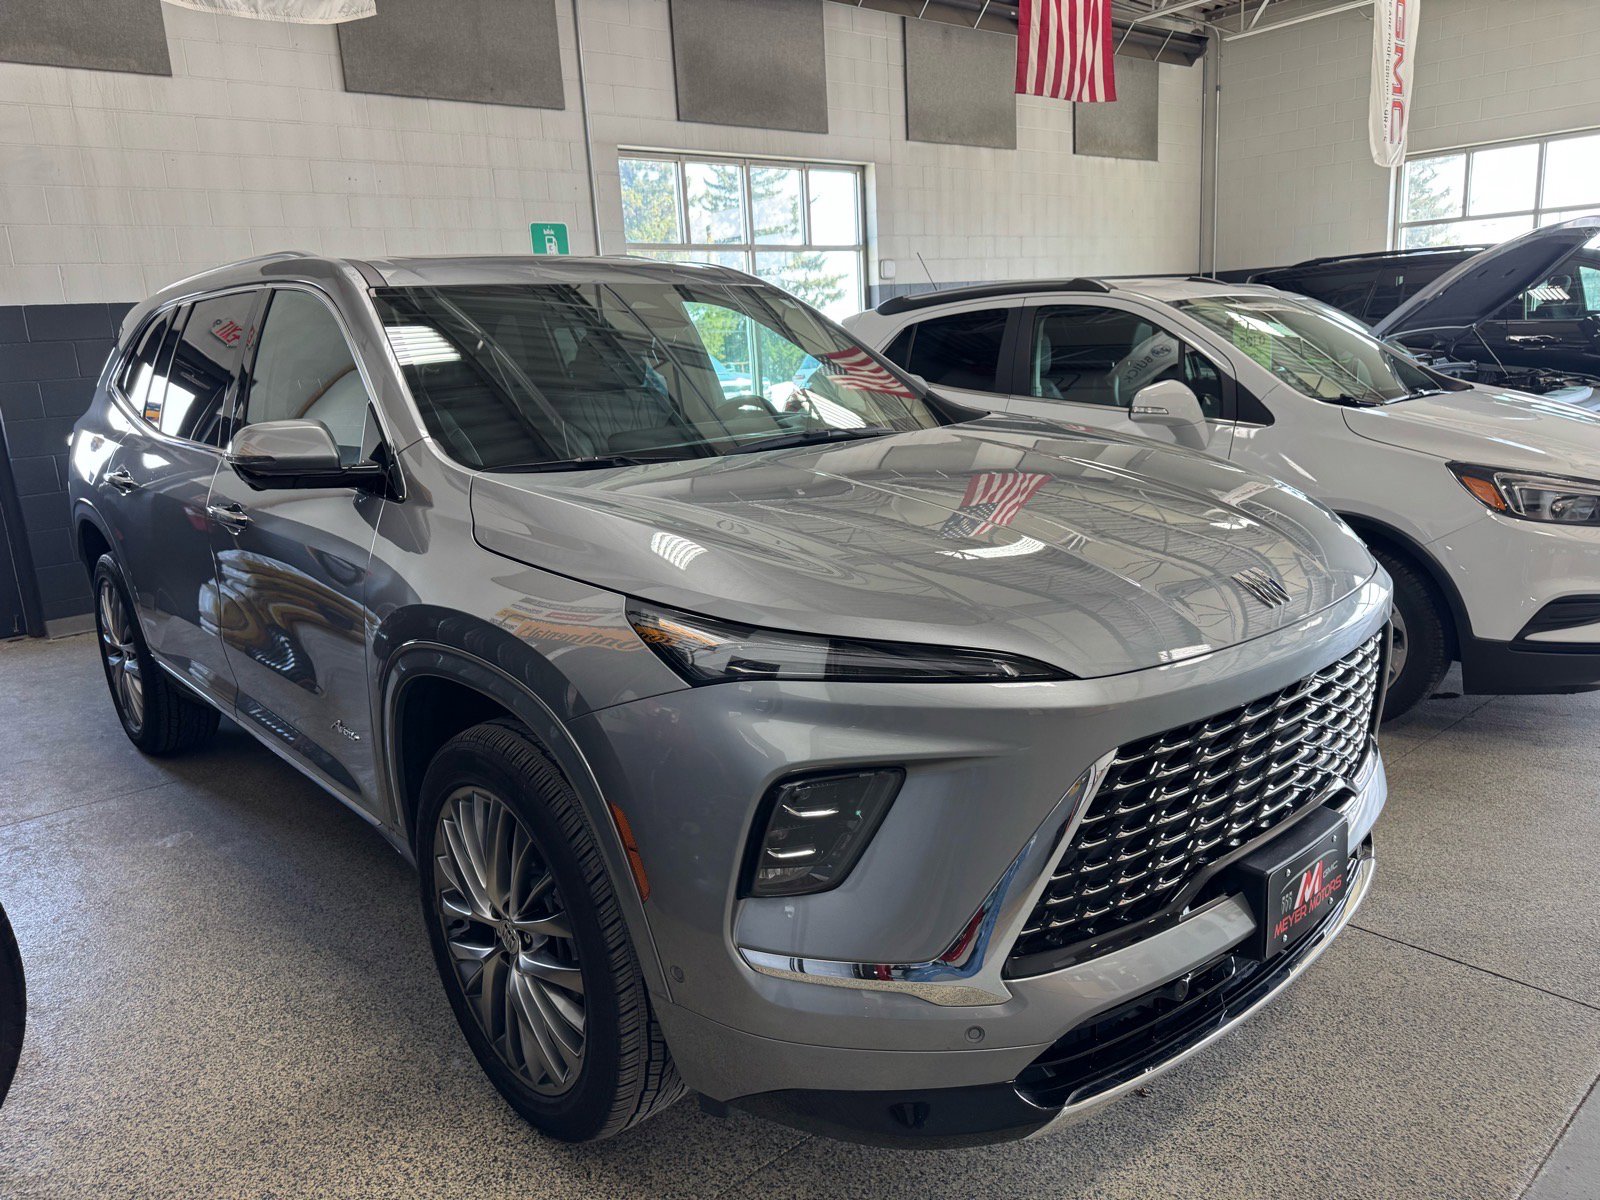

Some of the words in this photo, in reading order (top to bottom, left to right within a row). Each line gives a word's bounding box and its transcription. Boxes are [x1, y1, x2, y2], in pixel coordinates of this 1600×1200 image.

[1390, 0, 1406, 145] GMC
[1274, 905, 1307, 939] MEYER
[1308, 874, 1342, 914] MOTORS
